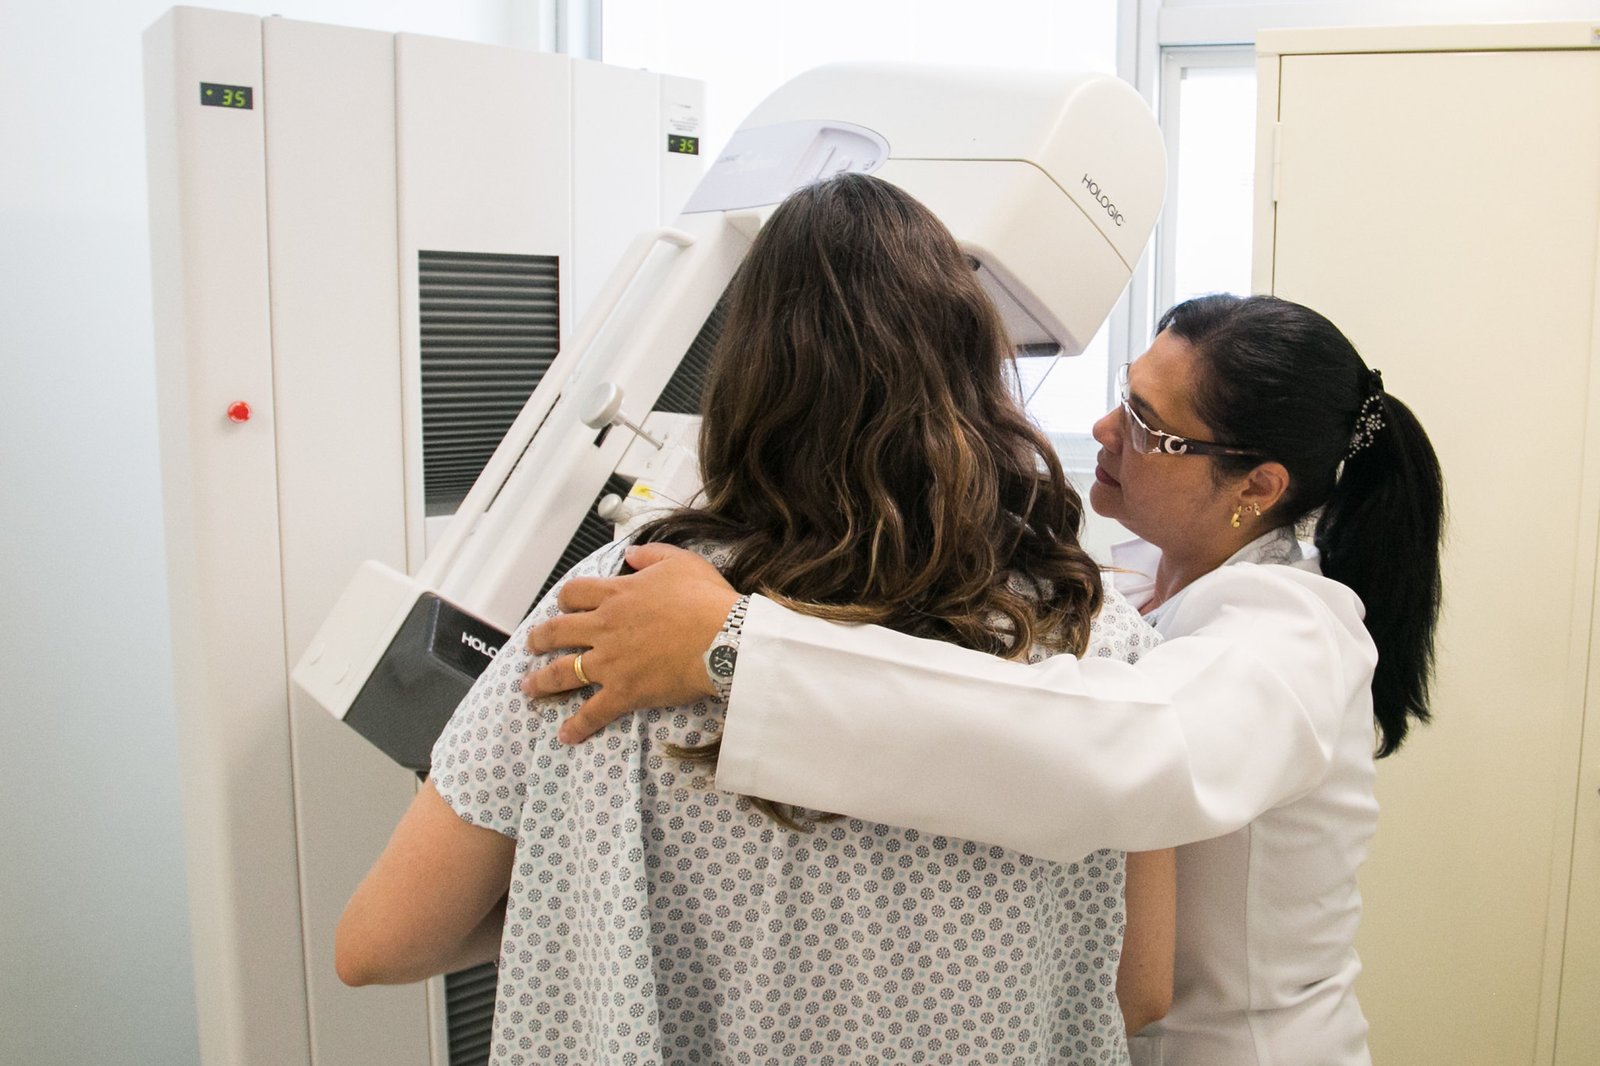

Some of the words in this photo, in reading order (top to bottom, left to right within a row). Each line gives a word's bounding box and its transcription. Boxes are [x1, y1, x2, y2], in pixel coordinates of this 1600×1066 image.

[222, 89, 246, 107] 35
[679, 138, 694, 153] 35
[1081, 173, 1124, 227] HOLOGIC
